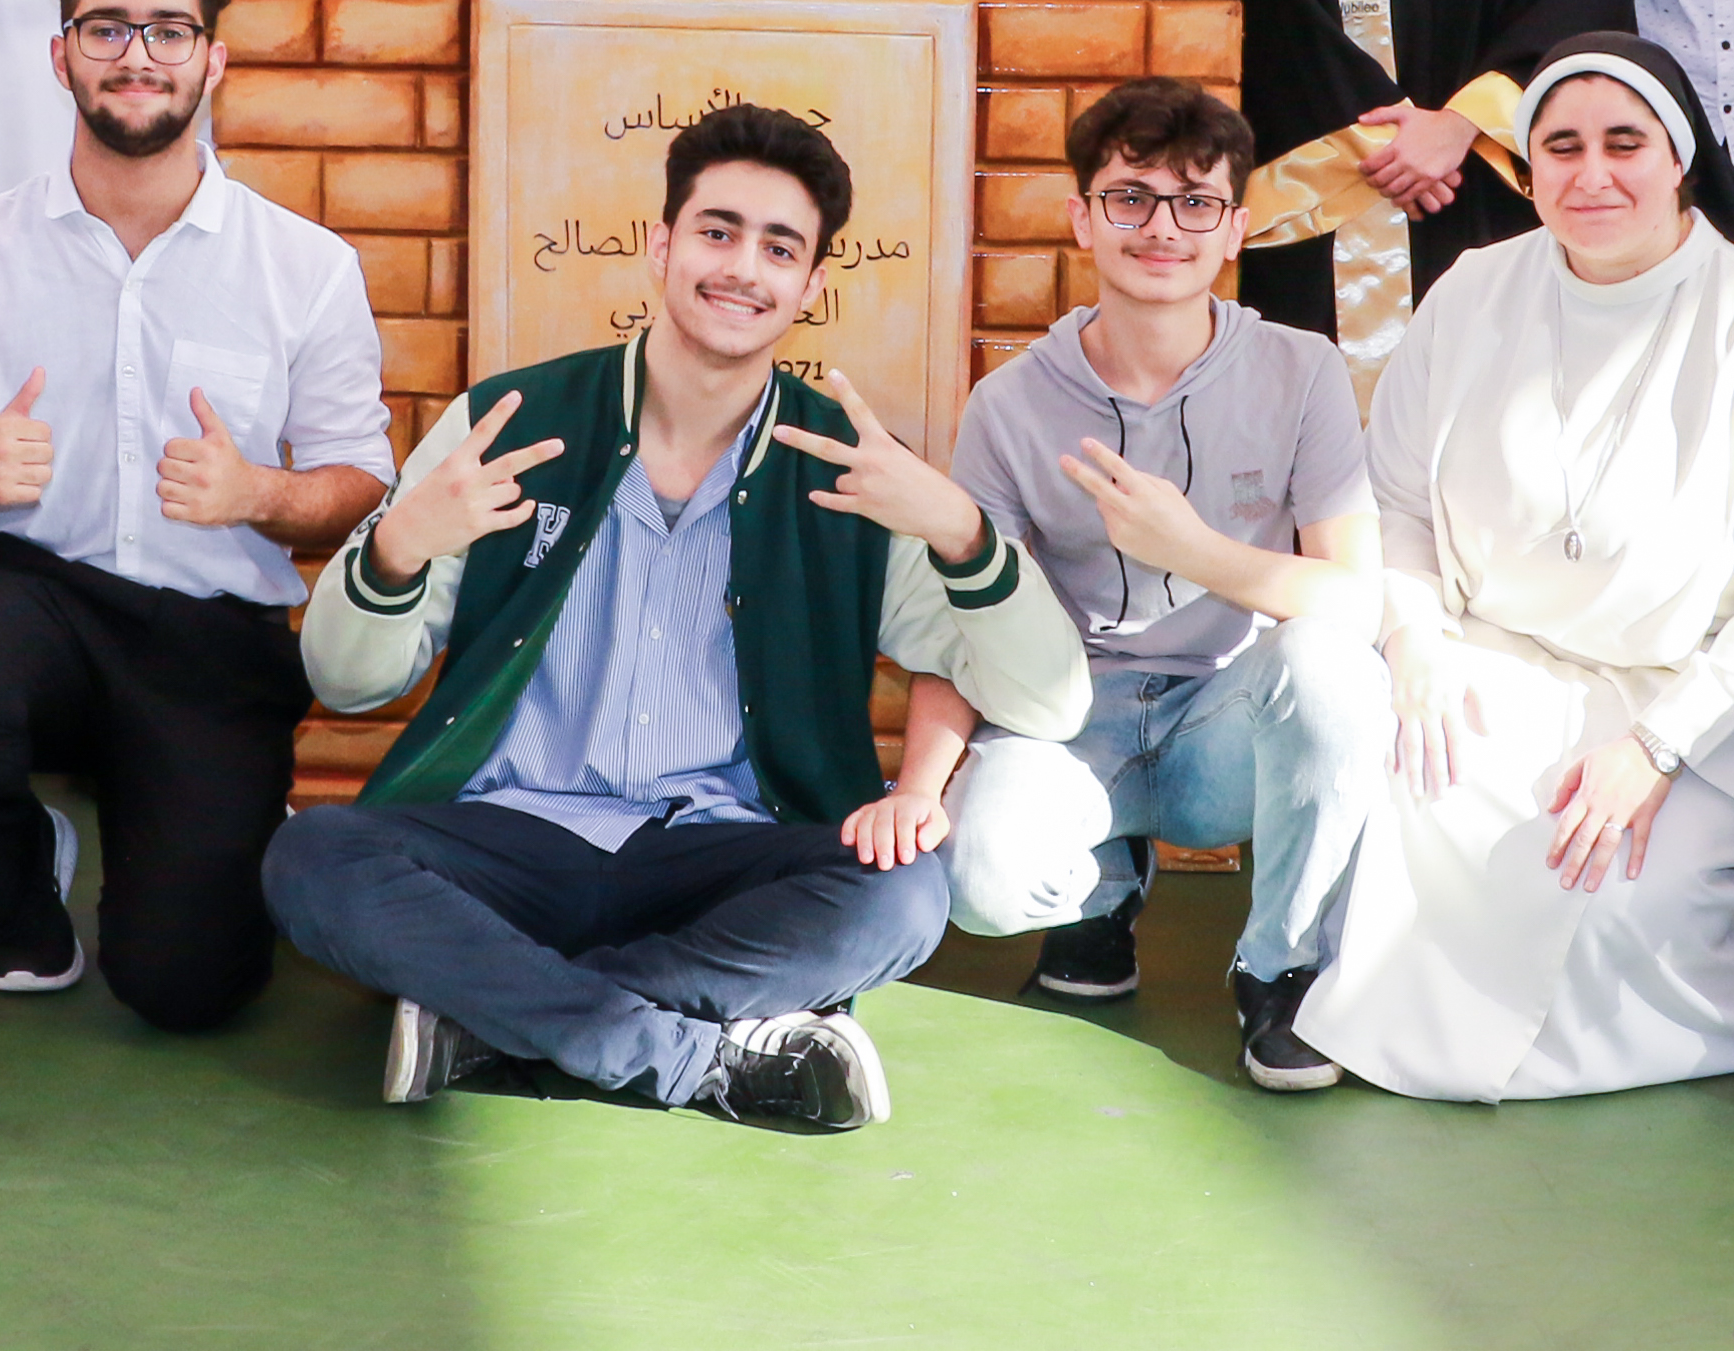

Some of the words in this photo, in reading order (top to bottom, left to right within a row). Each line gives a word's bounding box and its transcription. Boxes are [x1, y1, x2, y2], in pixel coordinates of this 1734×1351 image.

[532, 220, 648, 272] الصالح
[825, 238, 910, 270] مدرس
[610, 300, 657, 339] بي
